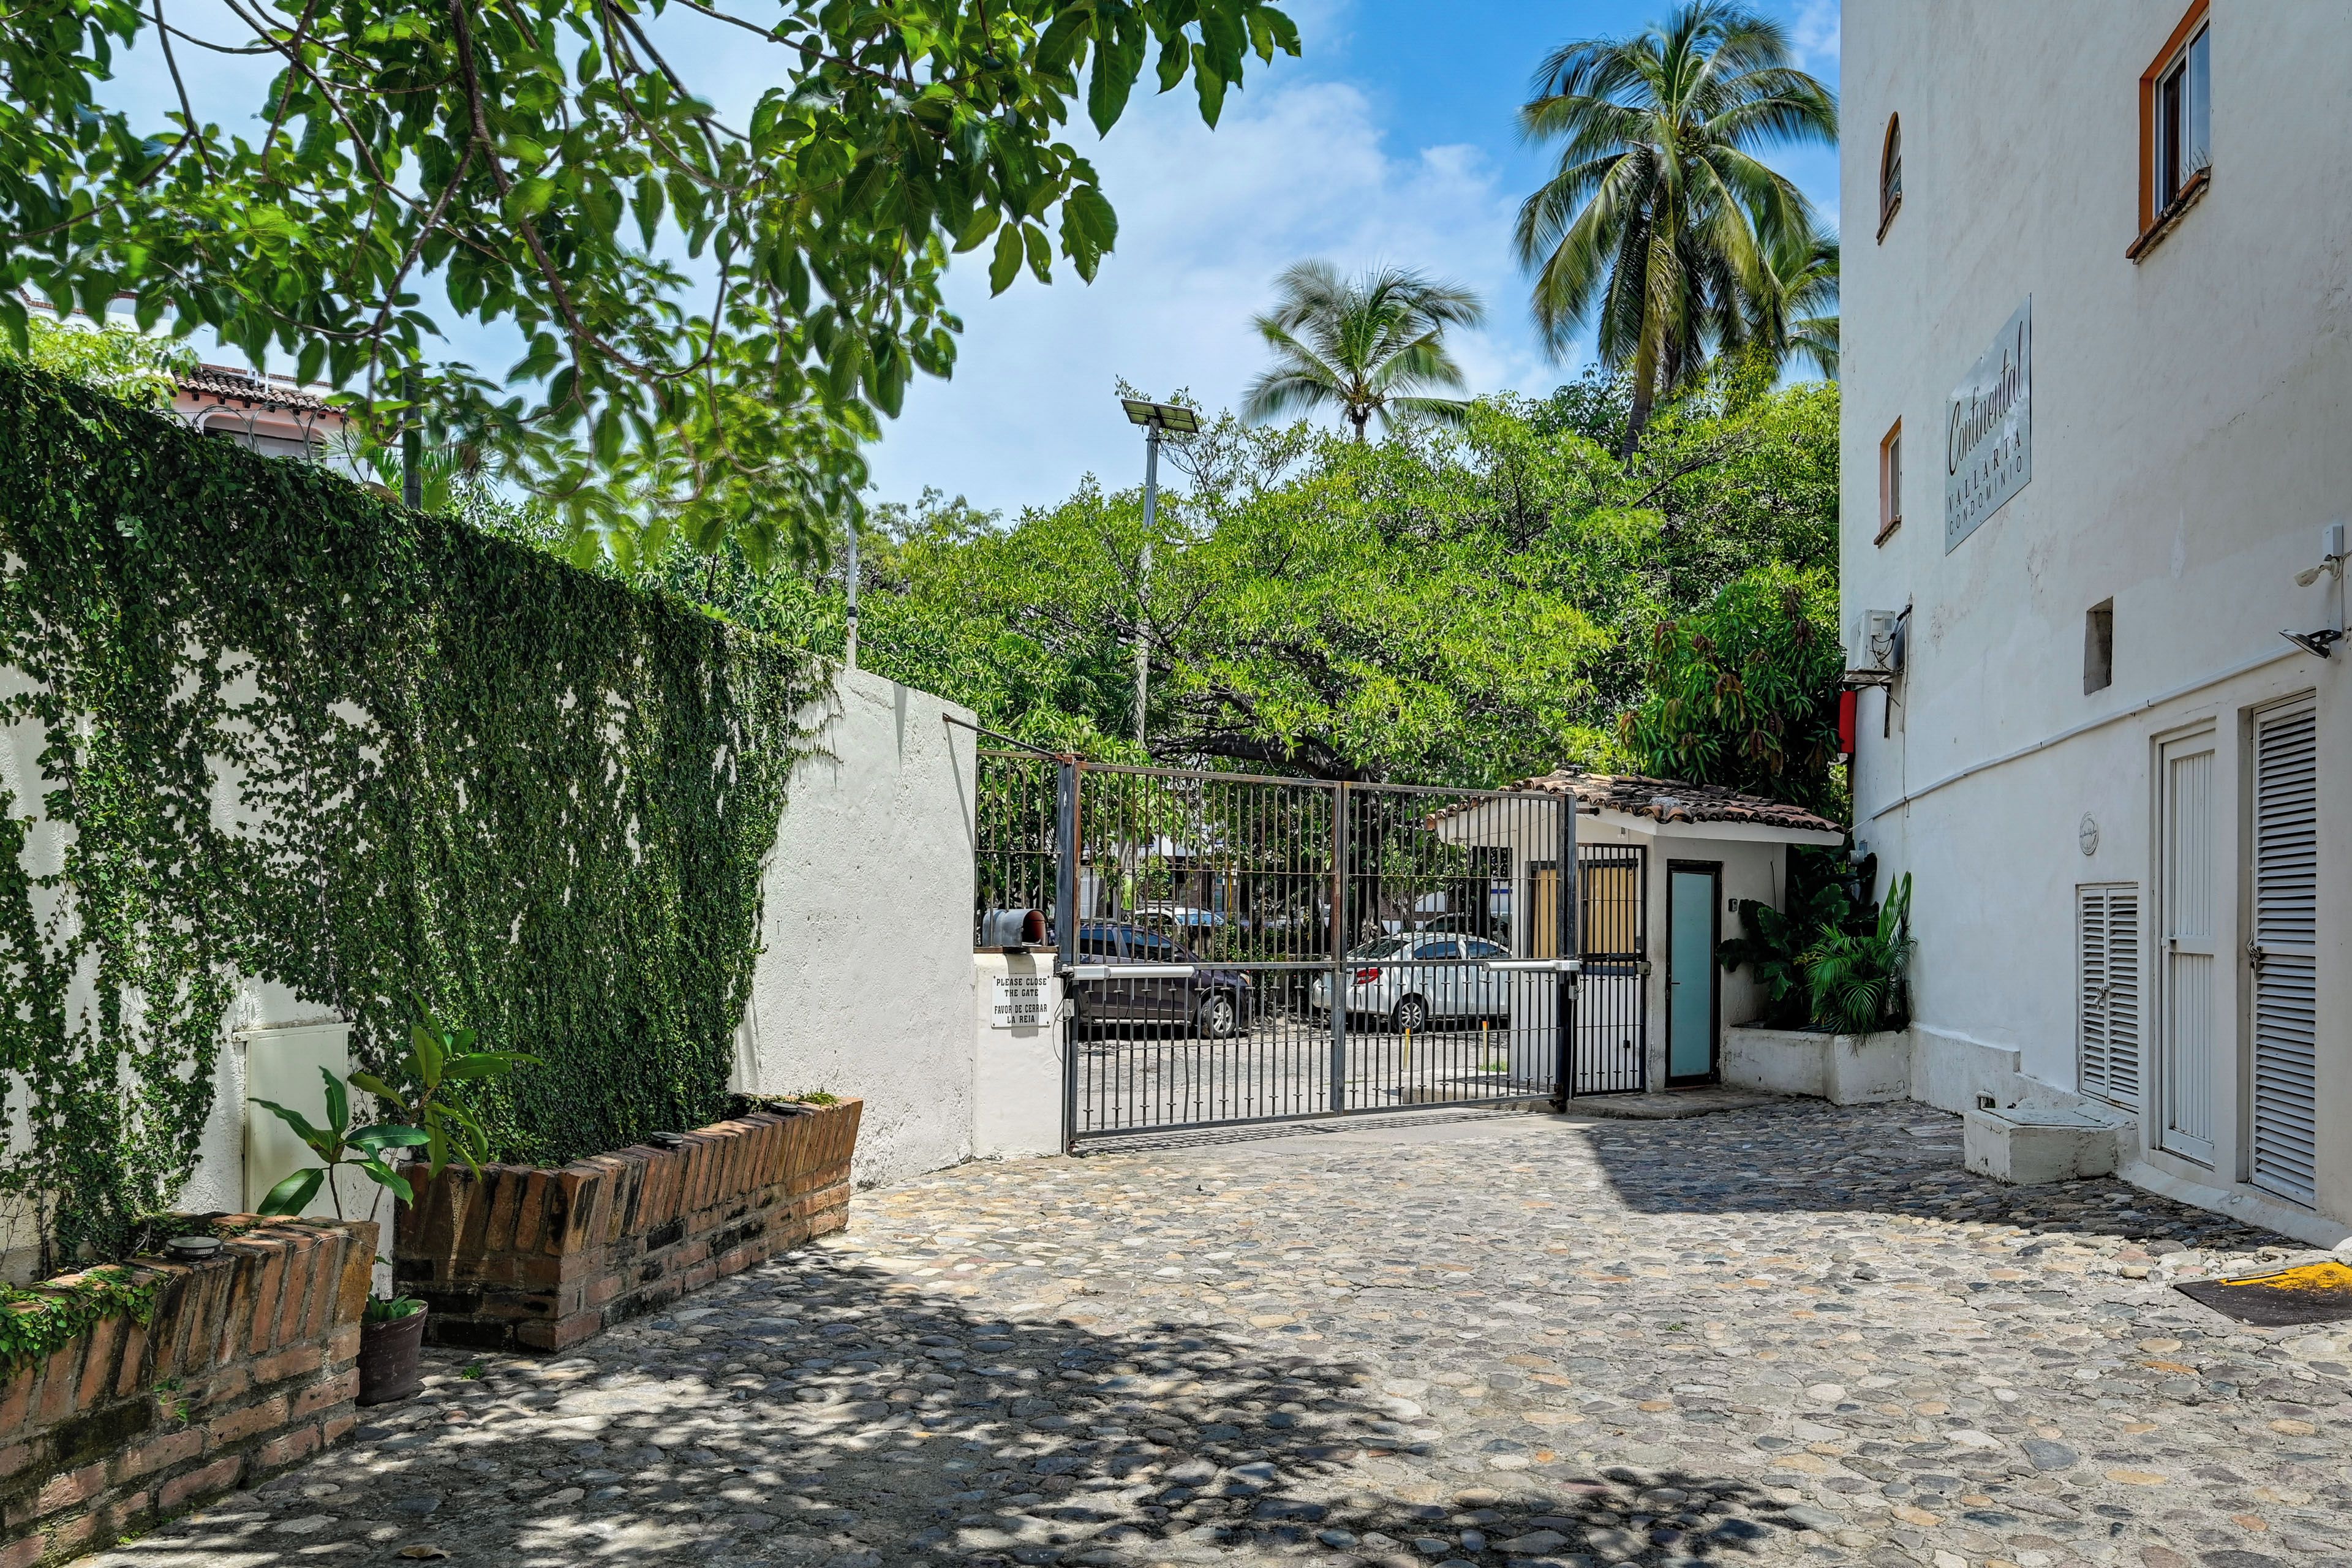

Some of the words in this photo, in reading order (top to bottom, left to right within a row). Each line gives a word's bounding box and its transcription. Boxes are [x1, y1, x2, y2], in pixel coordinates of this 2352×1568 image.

[1948, 320, 2023, 477] Continental
[1948, 428, 2021, 514] VALLARTA
[1949, 455, 2022, 535] CONDOMINIO
[994, 1005, 1012, 1014] FAVOR
[1015, 1005, 1022, 1013] DE
[1025, 1004, 1047, 1012] CERRAR
